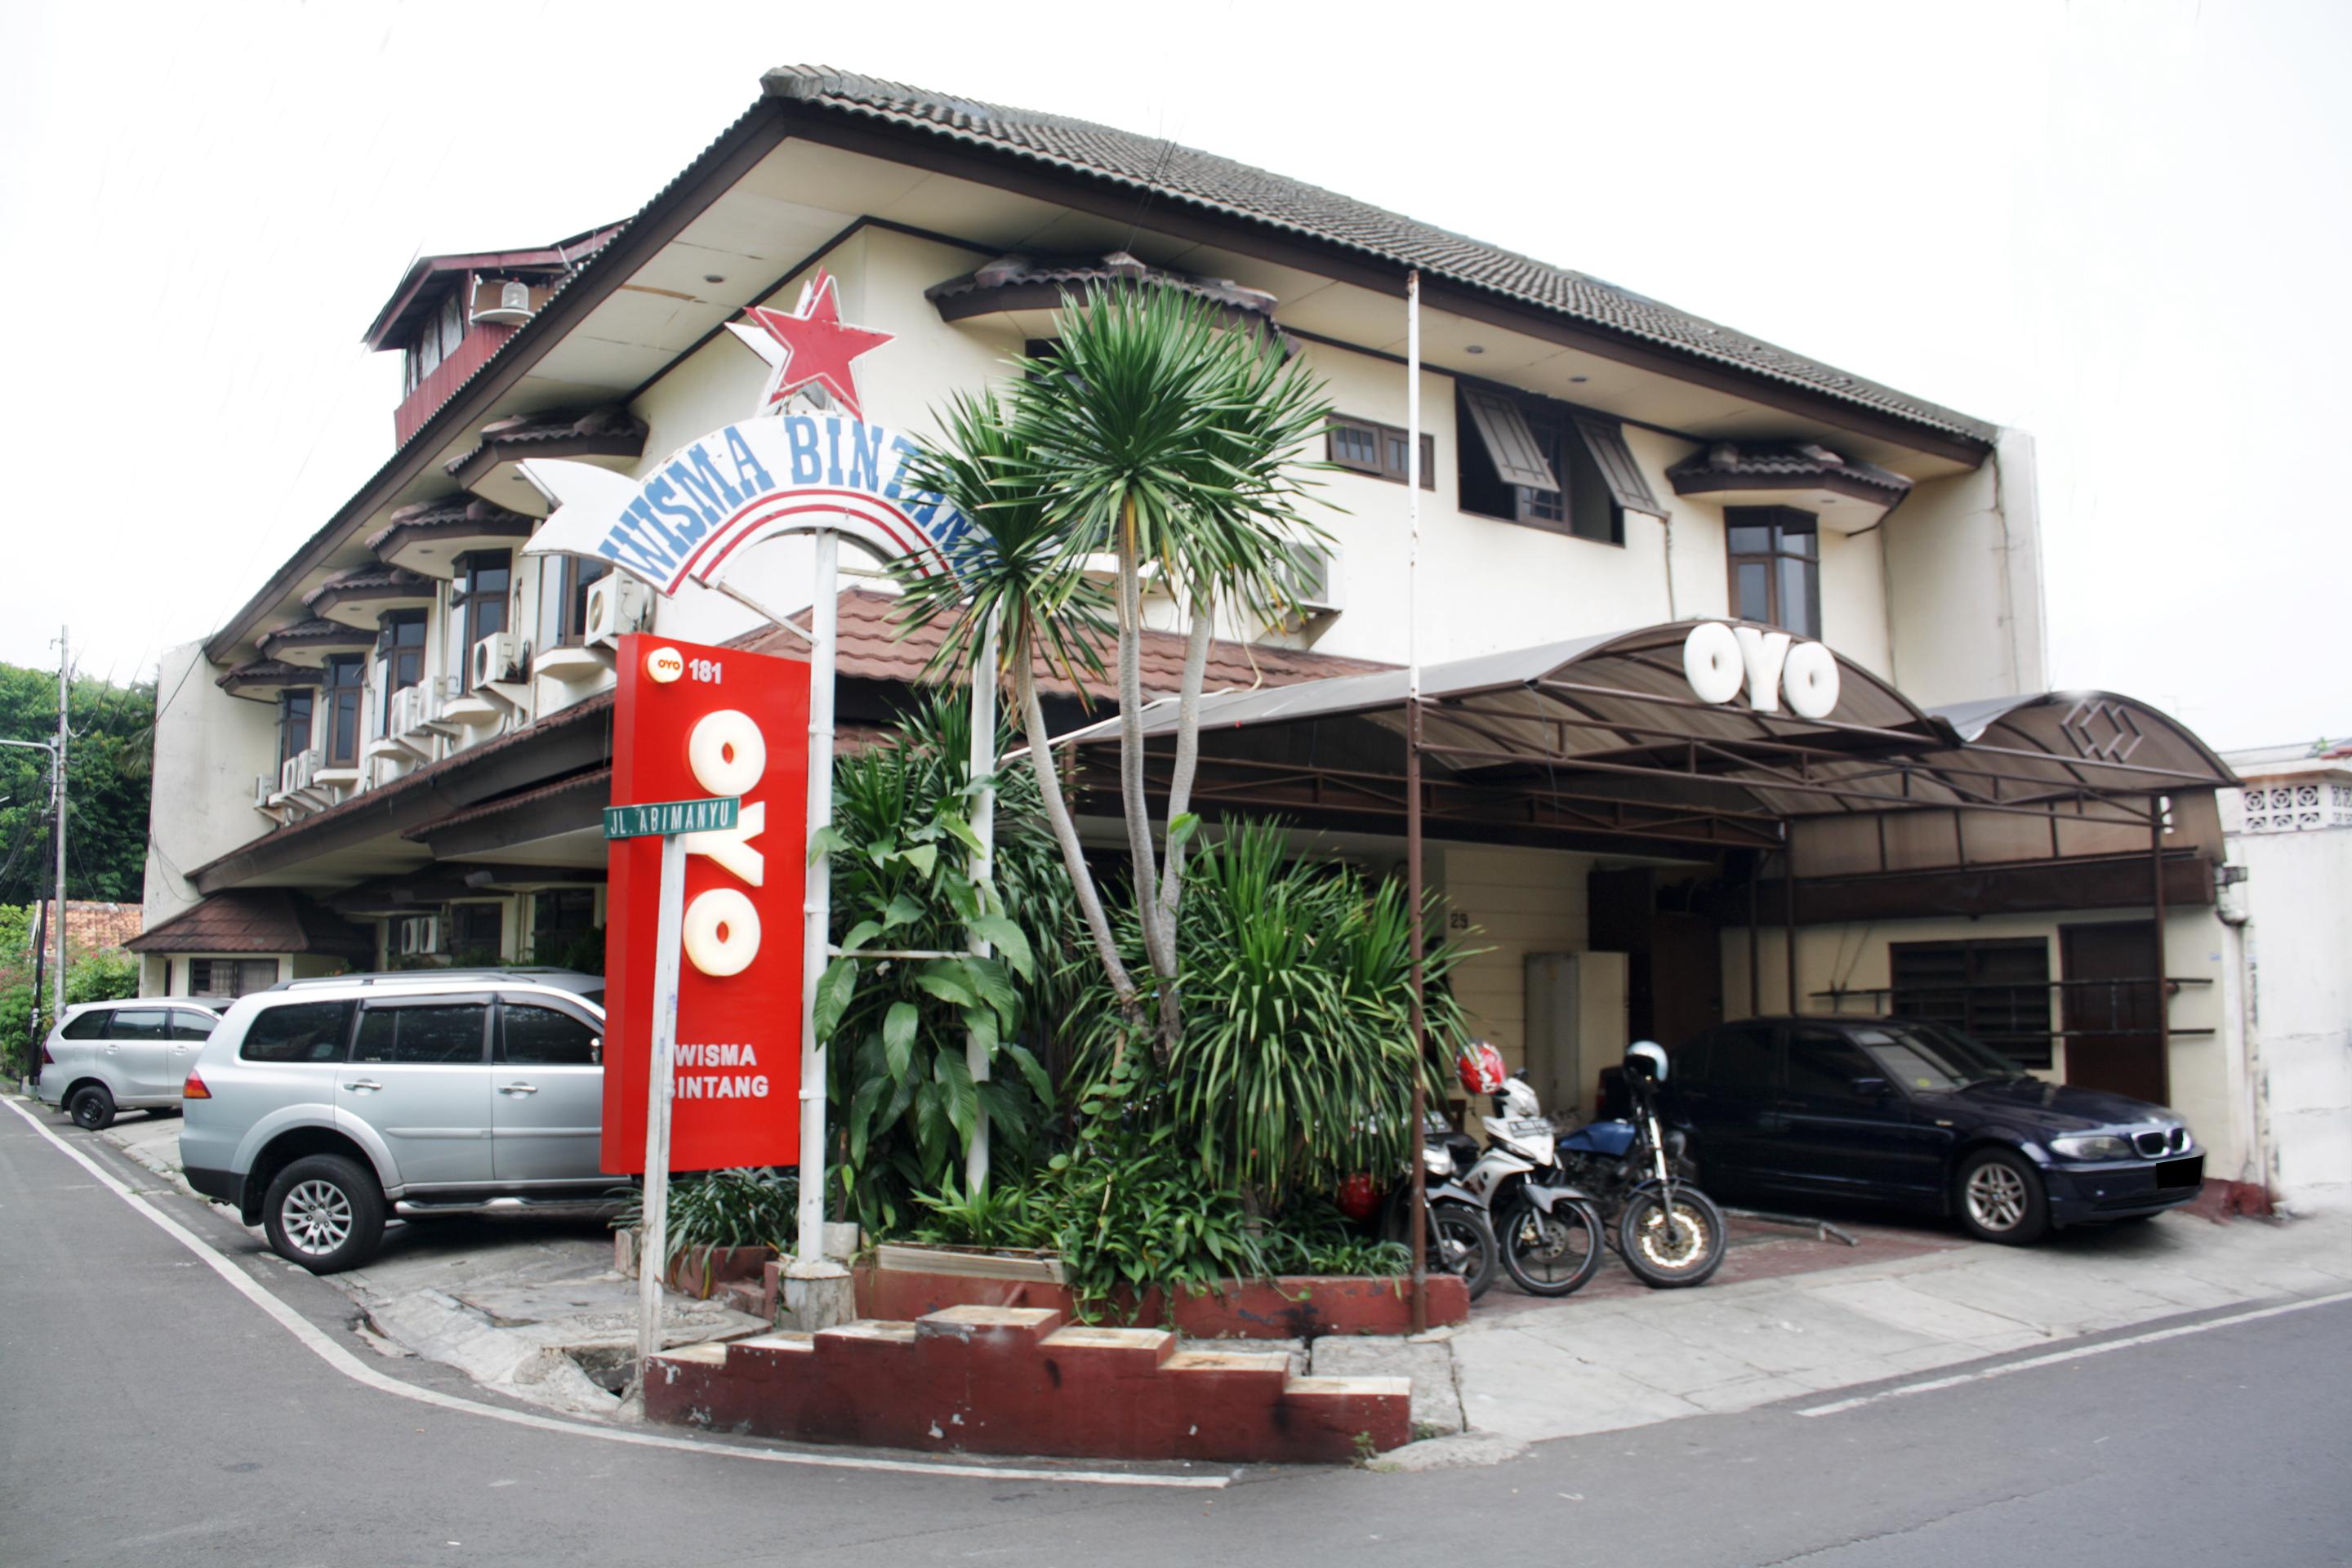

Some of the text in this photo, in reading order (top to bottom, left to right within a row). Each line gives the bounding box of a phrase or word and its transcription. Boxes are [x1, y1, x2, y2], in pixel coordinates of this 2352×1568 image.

[598, 425, 777, 582] WISMA
[658, 657, 722, 684] OYO 181
[1683, 621, 1840, 719] OYO
[610, 800, 729, 835] JL. ABIMANYU
[682, 709, 767, 977] OYO
[675, 1045, 757, 1067] WISMA
